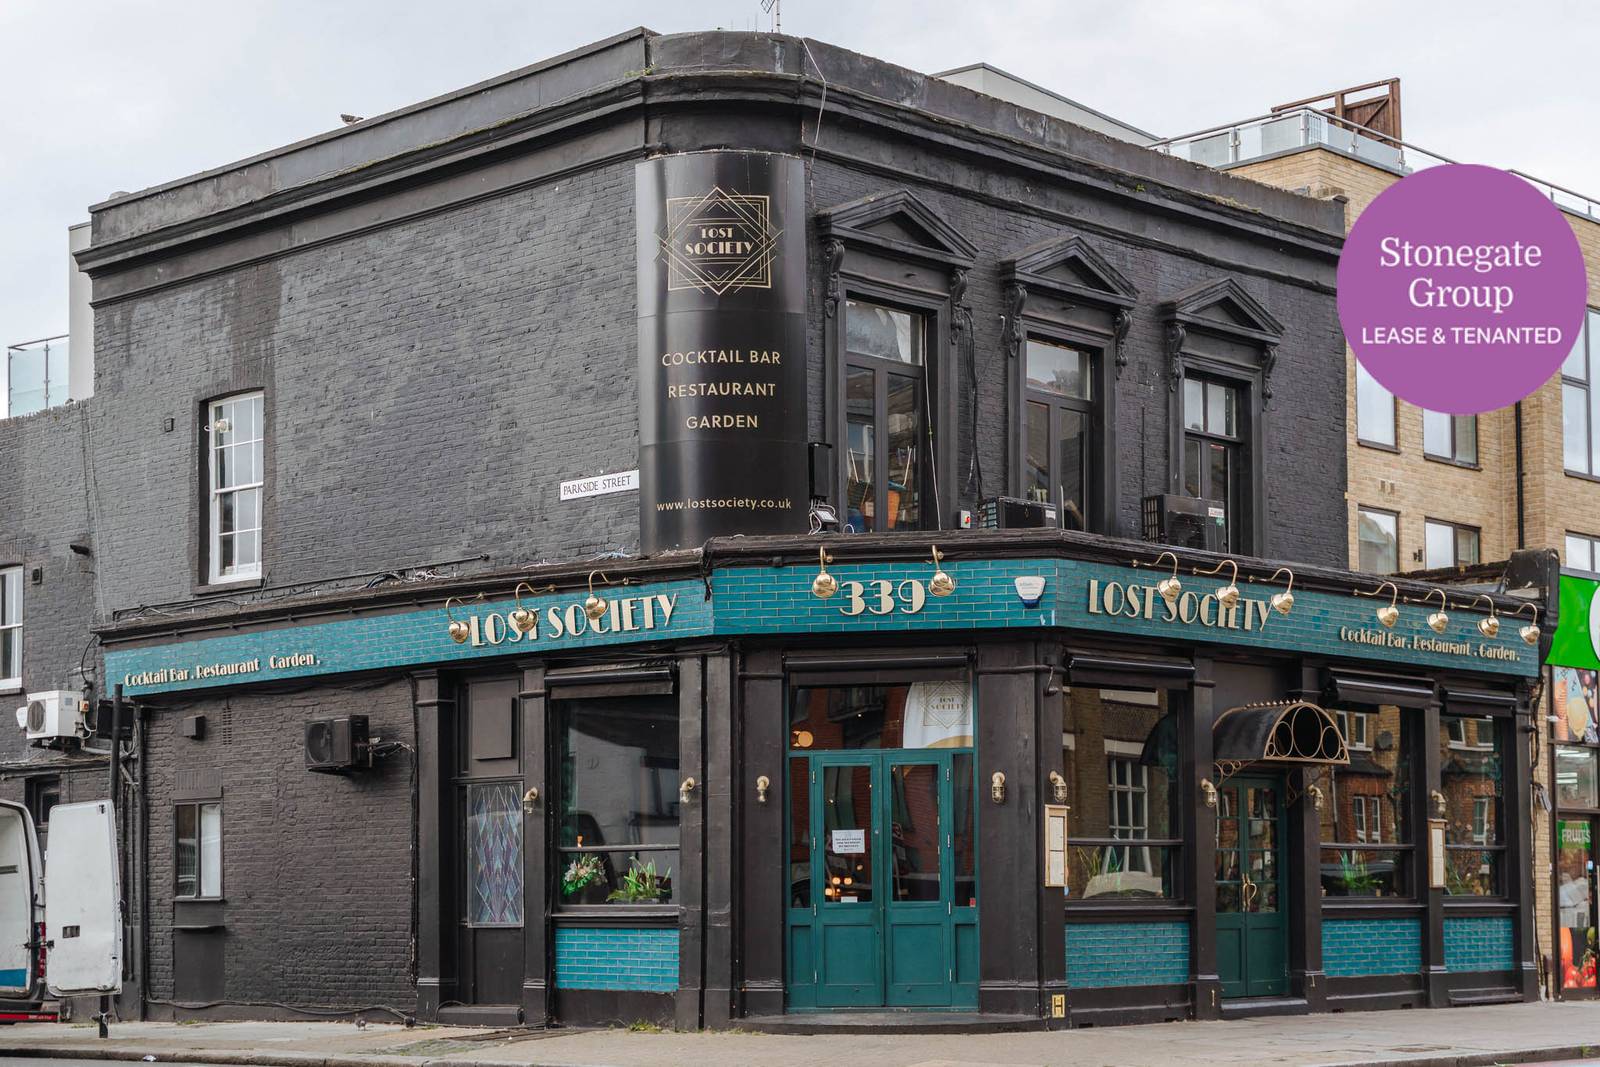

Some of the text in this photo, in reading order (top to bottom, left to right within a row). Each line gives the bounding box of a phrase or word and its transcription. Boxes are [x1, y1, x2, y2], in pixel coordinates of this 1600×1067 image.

[701, 227, 733, 239] LOST
[684, 241, 755, 256] SOCIETY
[662, 350, 781, 367] COCKTAIL BAR
[668, 382, 776, 399] RESTAURANT
[686, 415, 758, 429] GARDEN
[563, 475, 631, 496] PARKSIDE STREET
[656, 497, 792, 511] www.lostsociety.co.uk
[840, 579, 926, 616] 339
[1089, 579, 1158, 619] LOST
[1340, 625, 1386, 646] Cocktail
[124, 668, 168, 687] Cocktail
[1561, 828, 1591, 844] FRUITS
